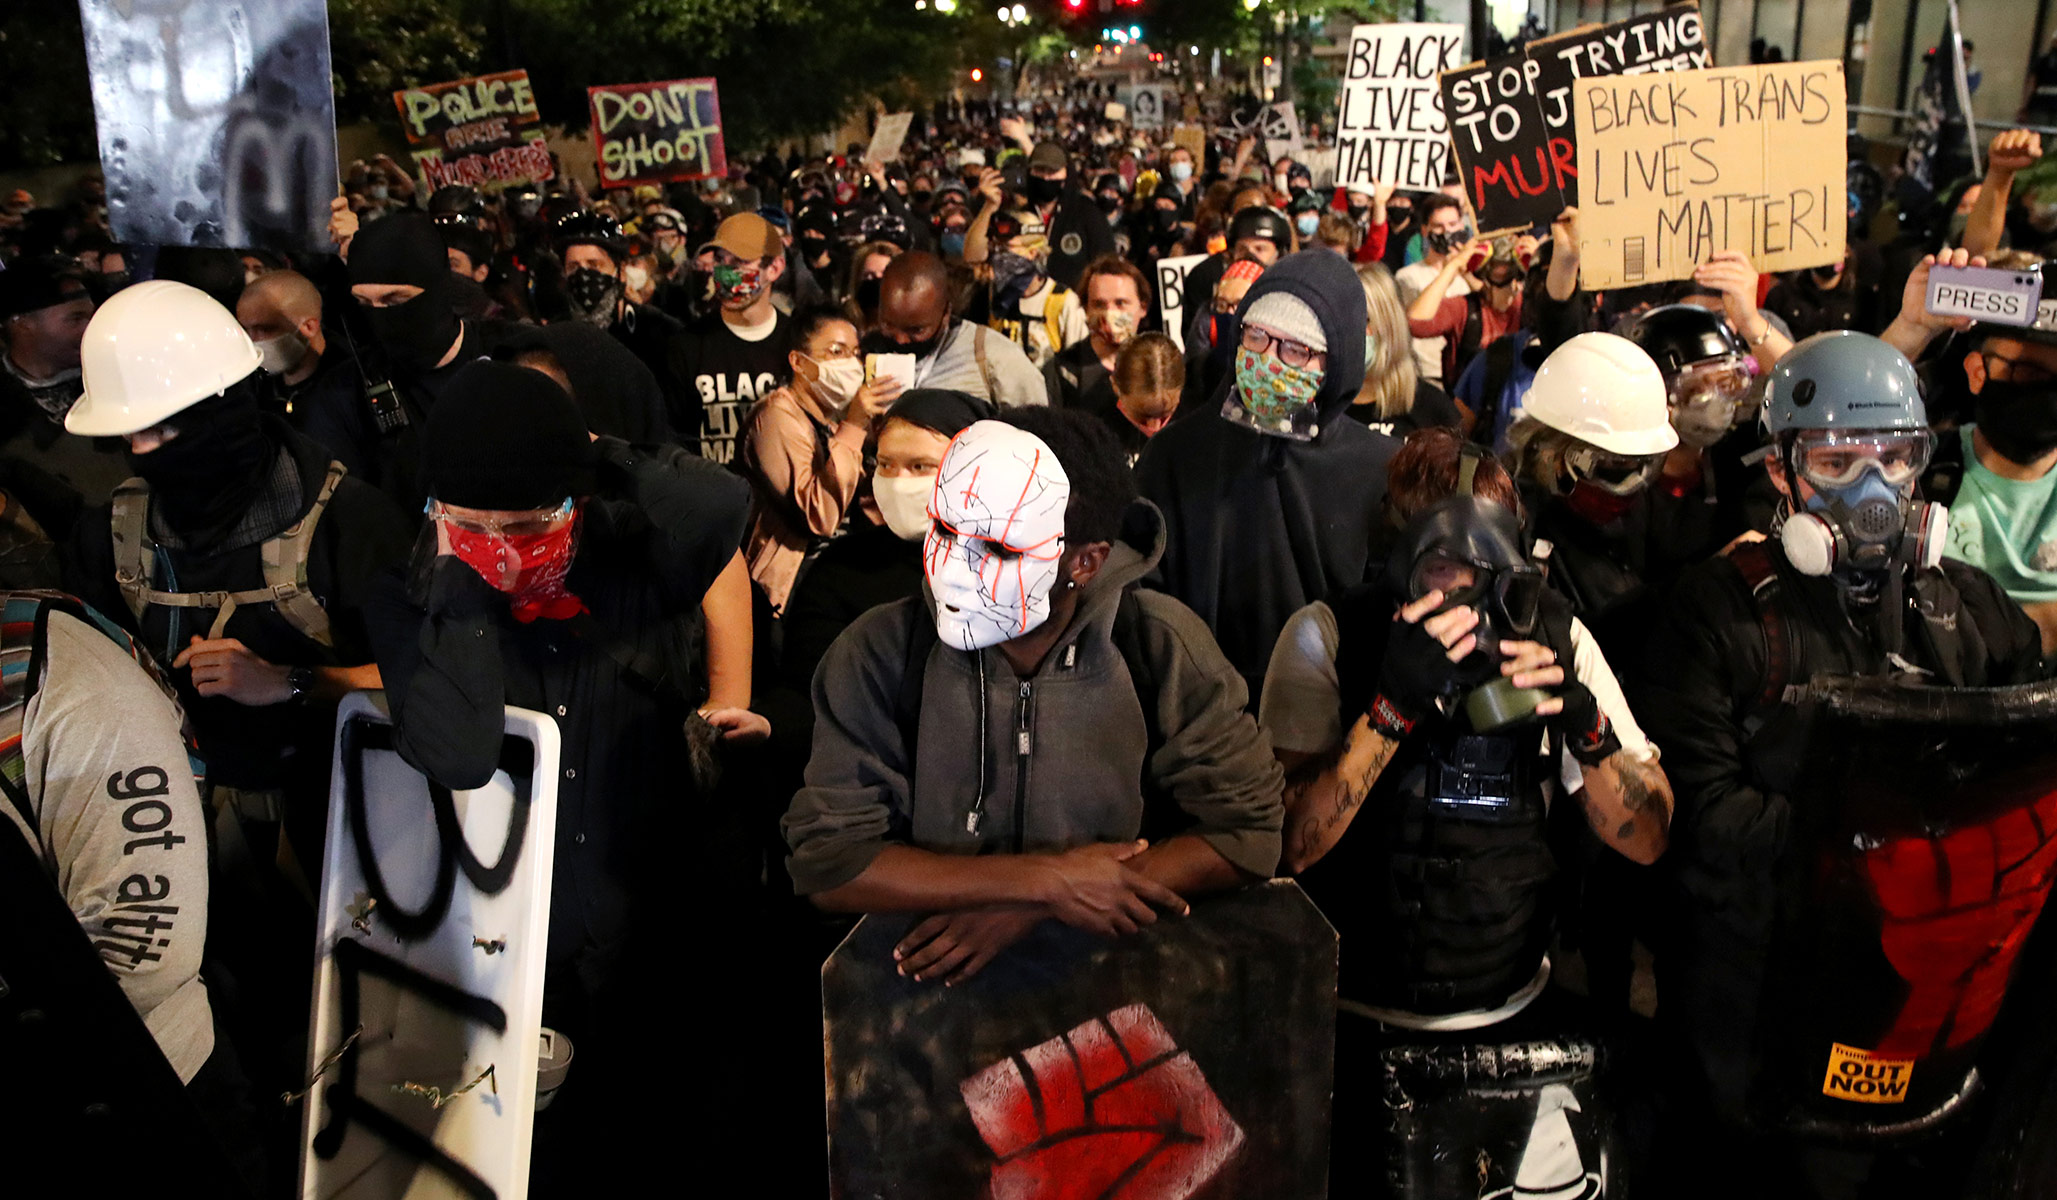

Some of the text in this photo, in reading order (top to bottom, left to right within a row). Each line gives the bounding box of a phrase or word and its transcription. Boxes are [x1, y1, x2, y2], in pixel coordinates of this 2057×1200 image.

[1349, 35, 1460, 80] BLACK
[1452, 60, 1540, 113] STOP
[1557, 13, 1702, 80] TRYING
[403, 79, 537, 137] POLICE
[1342, 87, 1448, 134] LIVES
[1455, 103, 1521, 153] TO
[1588, 84, 1697, 134] BLACK
[1707, 72, 1830, 128] TRANS
[602, 125, 720, 180] SHOOT
[1336, 136, 1447, 187] MATTER
[1595, 138, 1719, 205] LIVES
[1656, 185, 1828, 269] MATTER!
[1937, 286, 2019, 315] PRESS
[695, 372, 777, 403] BLAC
[106, 765, 186, 856] got
[1830, 1073, 1906, 1097] NOW
[1840, 1060, 1905, 1081] OUT
